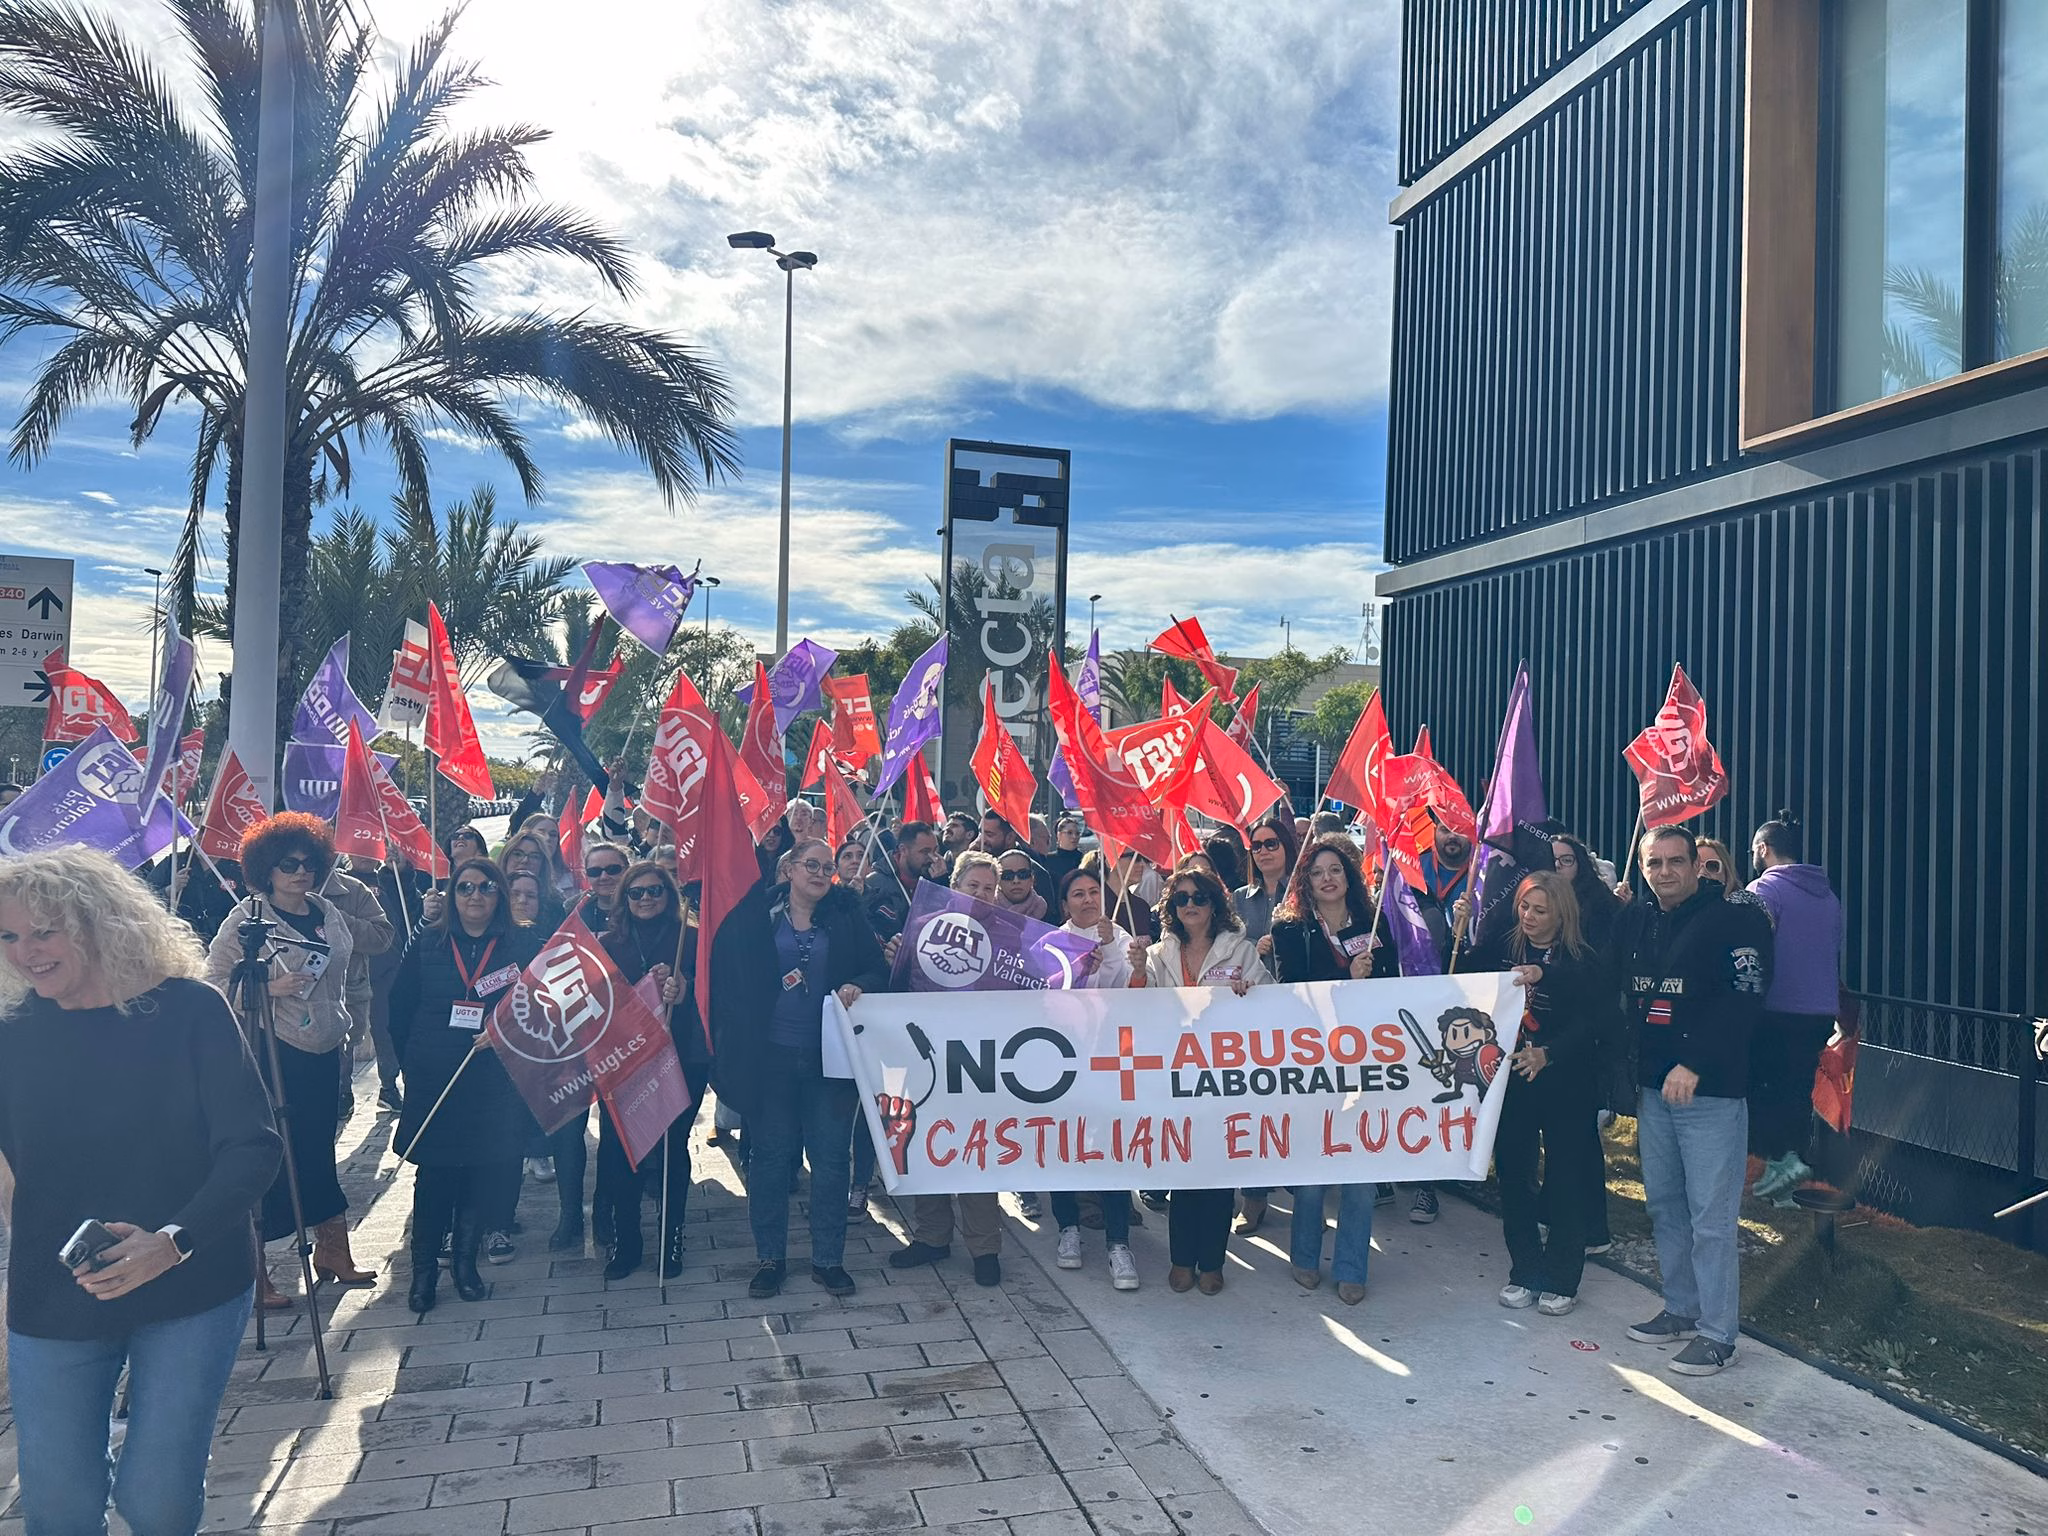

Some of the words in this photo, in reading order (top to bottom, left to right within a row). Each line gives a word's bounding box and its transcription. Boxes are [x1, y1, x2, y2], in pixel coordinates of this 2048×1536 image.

[21, 628, 63, 641] Darwin
[12, 647, 27, 656] 2-6
[32, 650, 39, 659] y
[929, 919, 984, 956] UGT
[996, 948, 1025, 969] País
[529, 942, 605, 1036] UGT
[993, 963, 1051, 990] Valencià
[456, 1008, 471, 1016] UGT
[549, 1033, 647, 1105] www.ugt.es
[947, 1027, 1077, 1104] NO
[1170, 1023, 1407, 1069] ABUSOS
[1170, 1064, 1410, 1098] LABORALES
[926, 1115, 1193, 1171] CASTILIAN
[1224, 1112, 1291, 1160] EN
